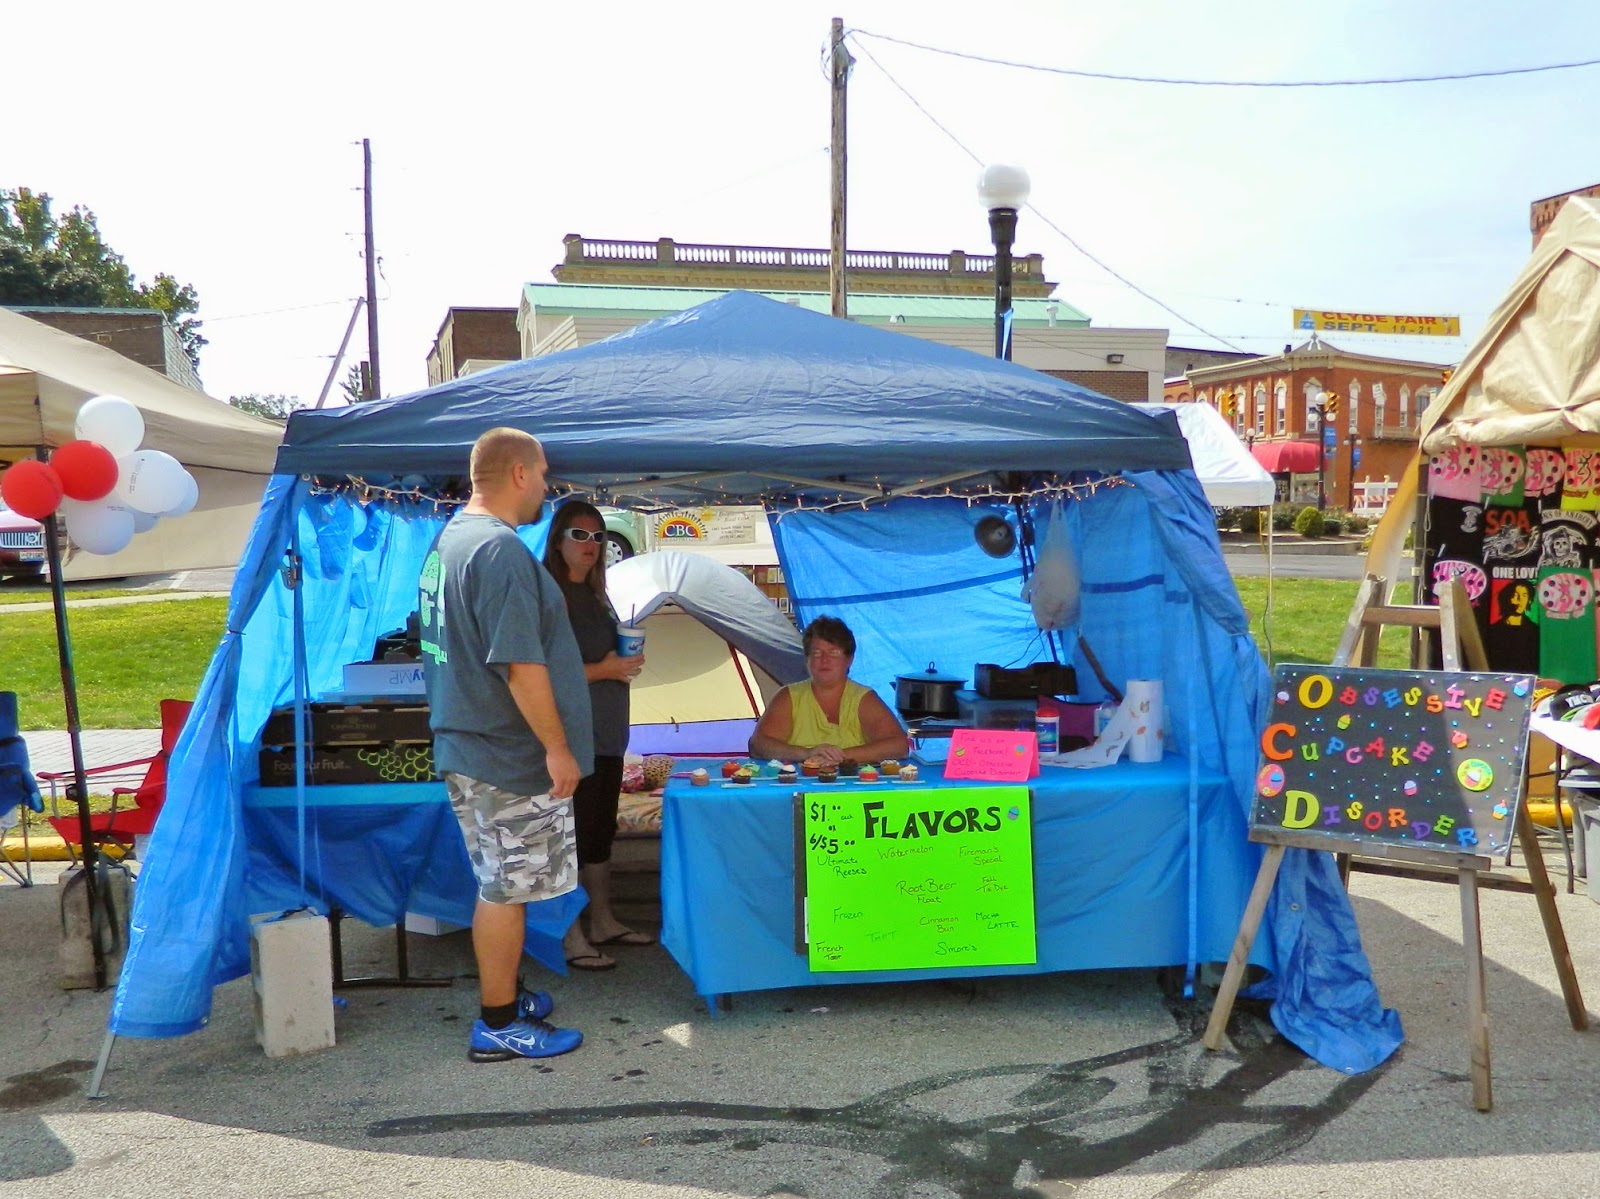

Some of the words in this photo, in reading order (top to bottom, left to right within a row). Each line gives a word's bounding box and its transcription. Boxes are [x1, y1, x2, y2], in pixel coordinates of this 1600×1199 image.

[1321, 311, 1388, 323] CLYDE
[1394, 315, 1437, 325] FAIR
[1323, 321, 1379, 333] SEPT.
[1485, 510, 1531, 535] SOA
[665, 524, 696, 537] CBC
[1492, 566, 1514, 579] ONE
[1298, 674, 1507, 717] OBSESSIVE
[322, 759, 345, 769] Fruit
[862, 800, 1002, 839] FLAVORS
[1281, 789, 1479, 847] DISORDER
[877, 844, 934, 860] Watermelon
[817, 855, 858, 867] Ultimate
[973, 855, 1003, 866] Special
[896, 880, 925, 895] Root
[925, 878, 957, 893] Beer
[916, 893, 942, 904] Float
[833, 905, 864, 924] Frozen
[919, 916, 959, 926] Cinnamon
[936, 924, 955, 934] Bun
[987, 920, 1019, 930] LATTE
[815, 940, 844, 953] French
